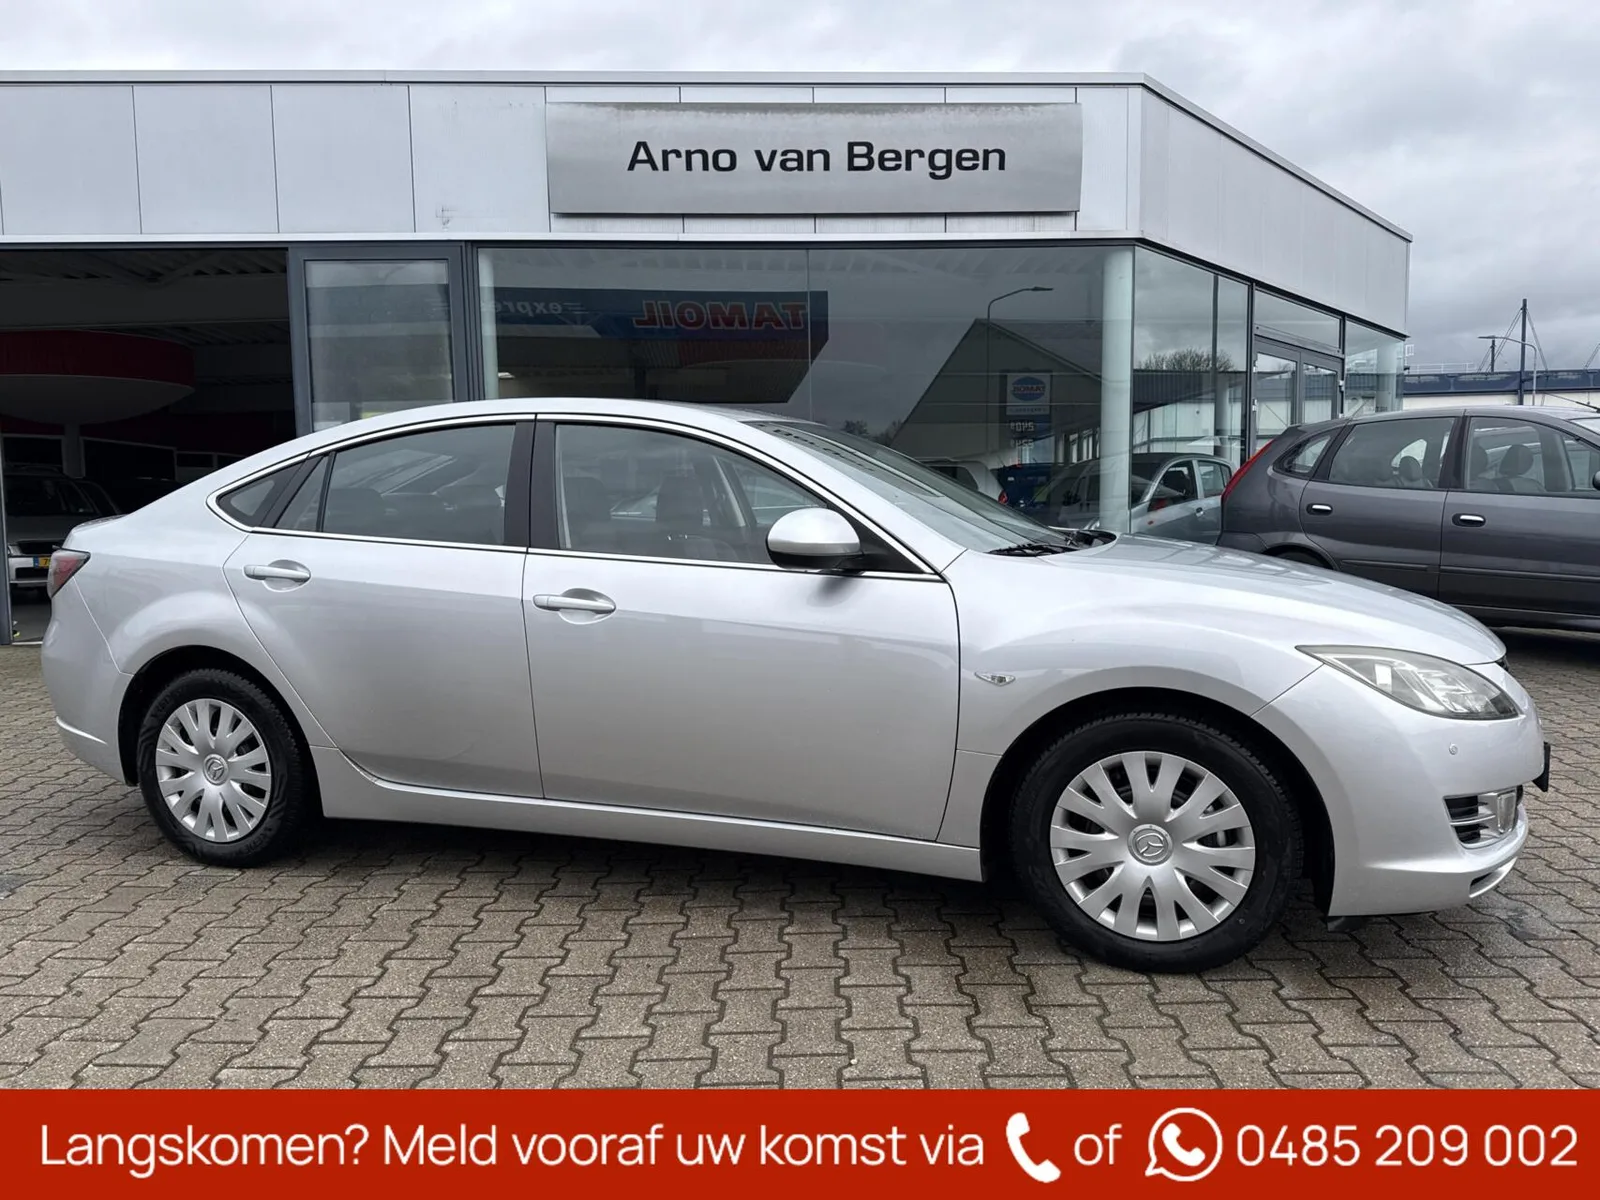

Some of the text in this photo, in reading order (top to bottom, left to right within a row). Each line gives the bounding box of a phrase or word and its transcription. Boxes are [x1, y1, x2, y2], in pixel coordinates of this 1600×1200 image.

[627, 141, 1006, 181] Arno van Bergen
